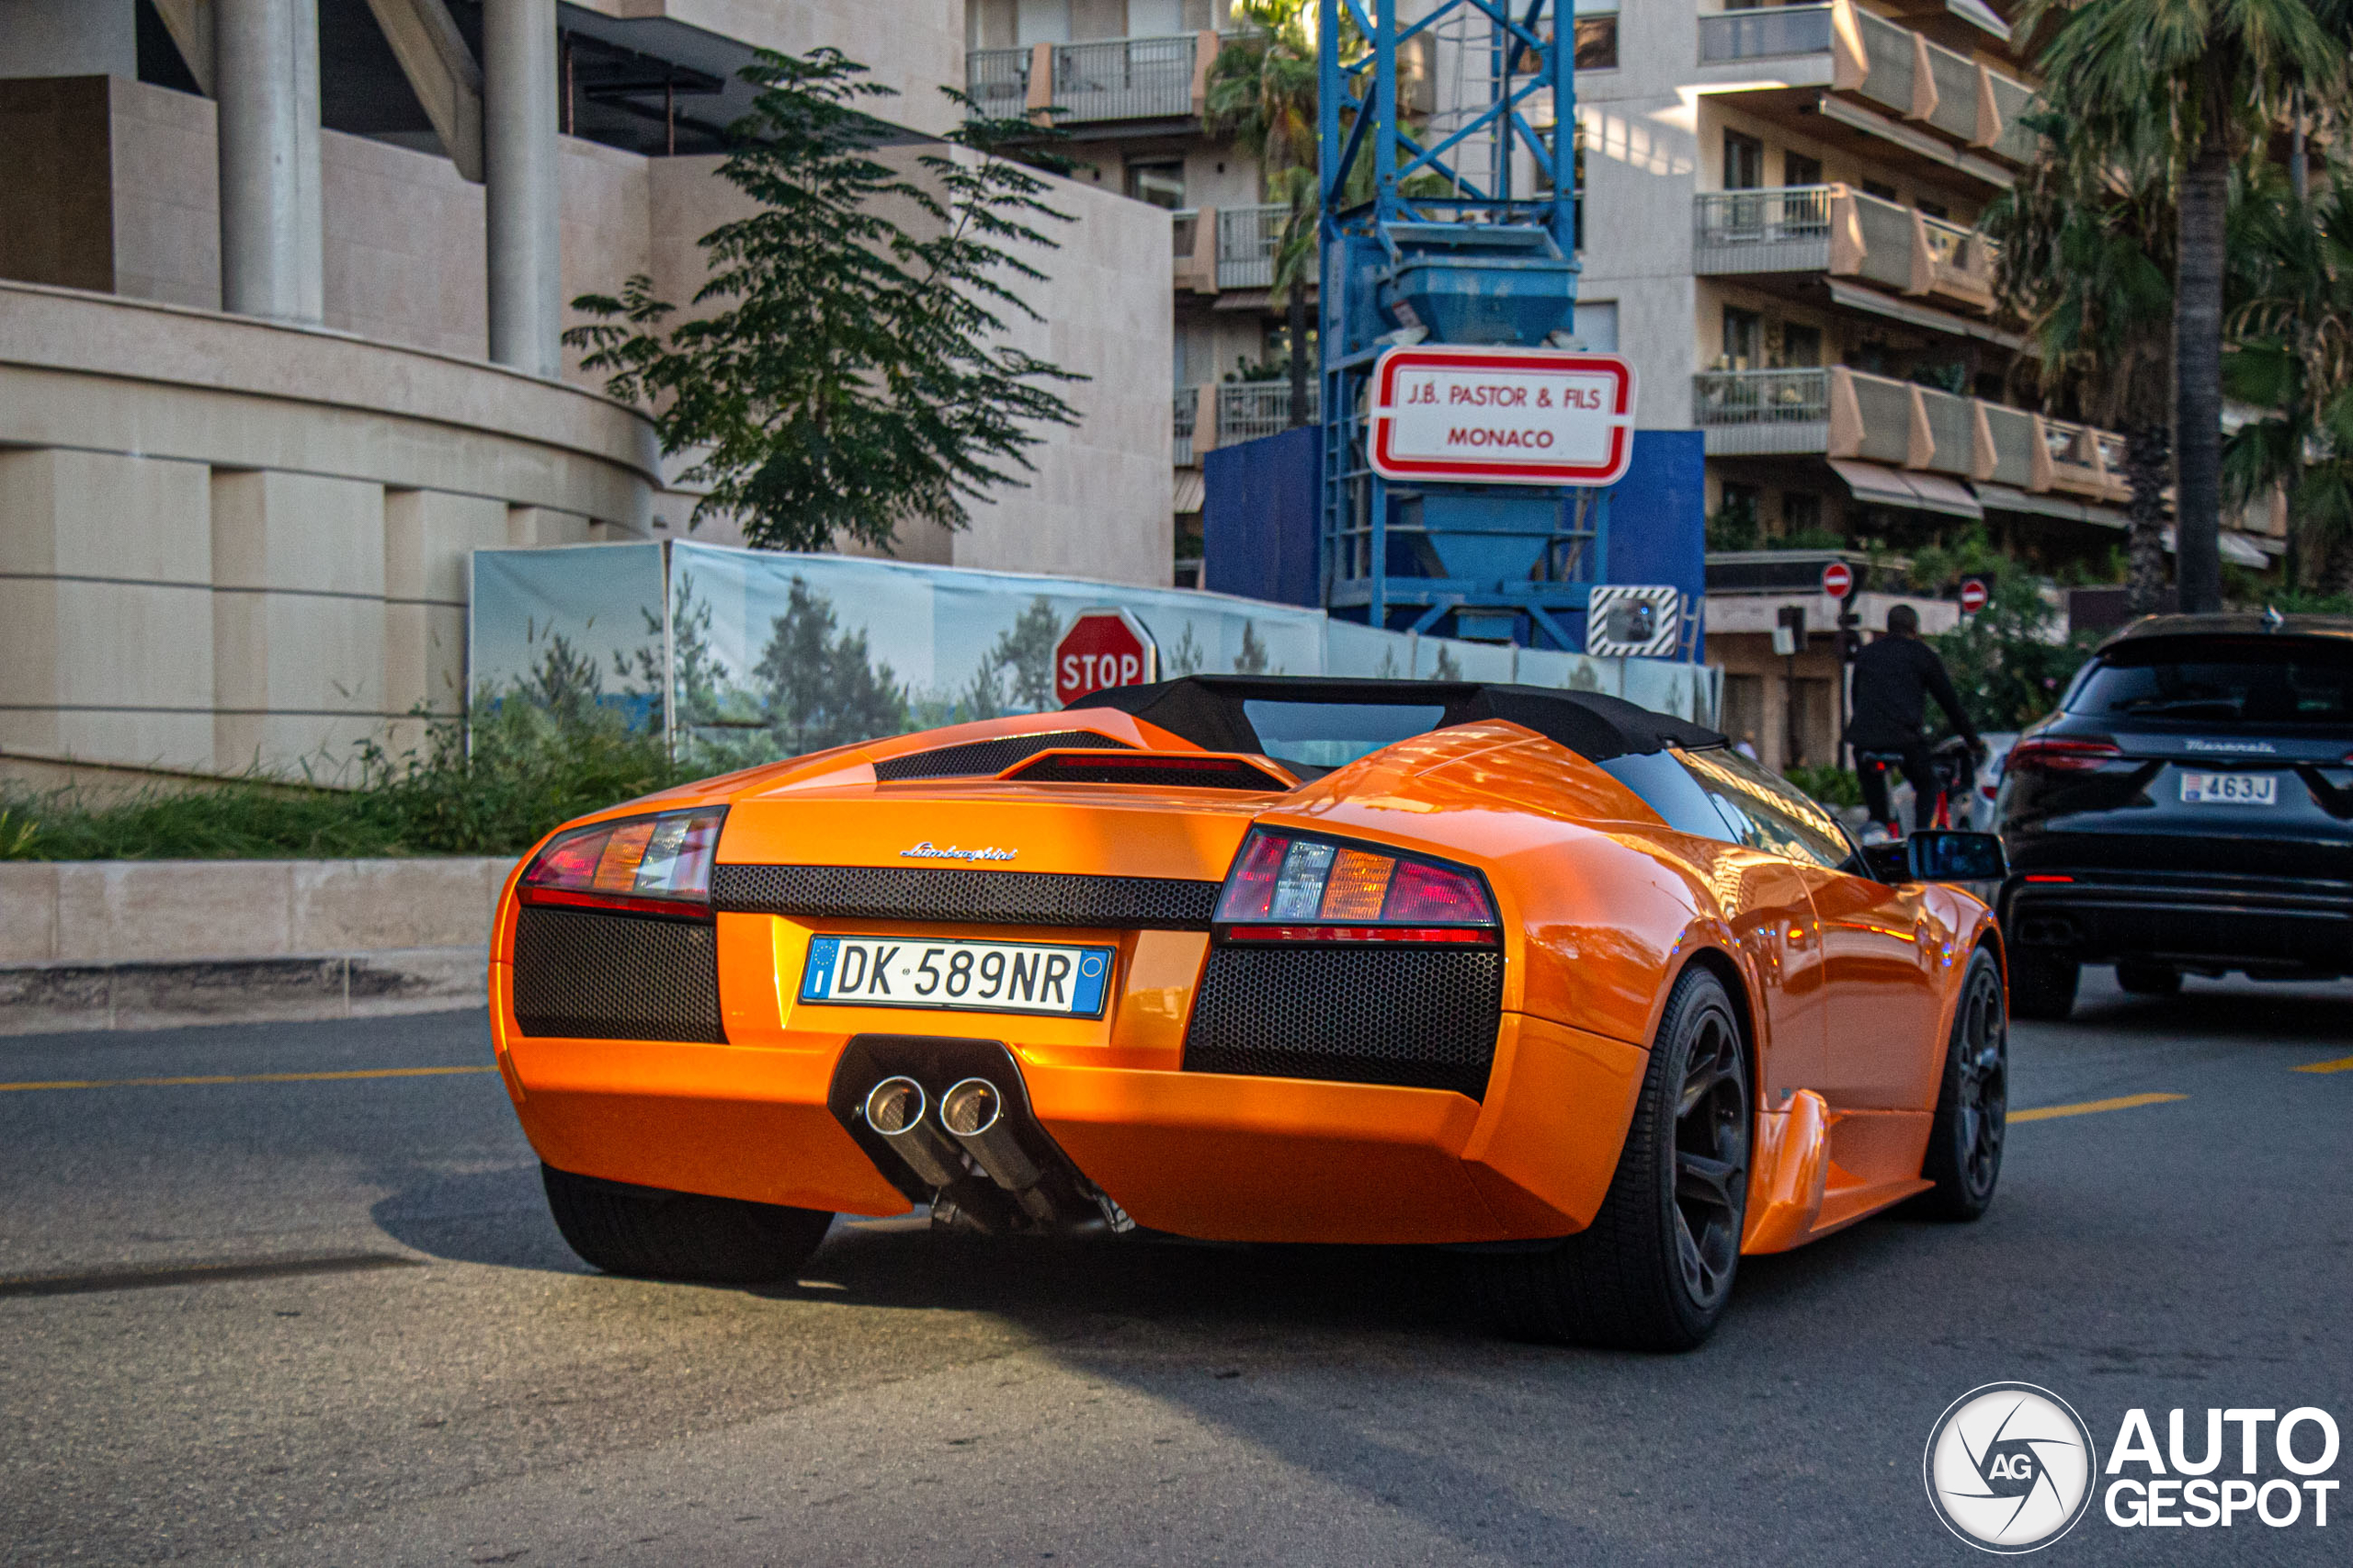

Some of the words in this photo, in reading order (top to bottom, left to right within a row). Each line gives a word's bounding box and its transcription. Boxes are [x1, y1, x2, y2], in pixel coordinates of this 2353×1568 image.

[1449, 384, 1528, 407] PASTOR
[1537, 388, 1553, 407] &
[1563, 388, 1601, 410] FILS
[1447, 427, 1554, 449] MONACO
[1062, 653, 1139, 691] STOP
[2208, 777, 2271, 799] 463J
[900, 841, 1017, 862] Lamborghini
